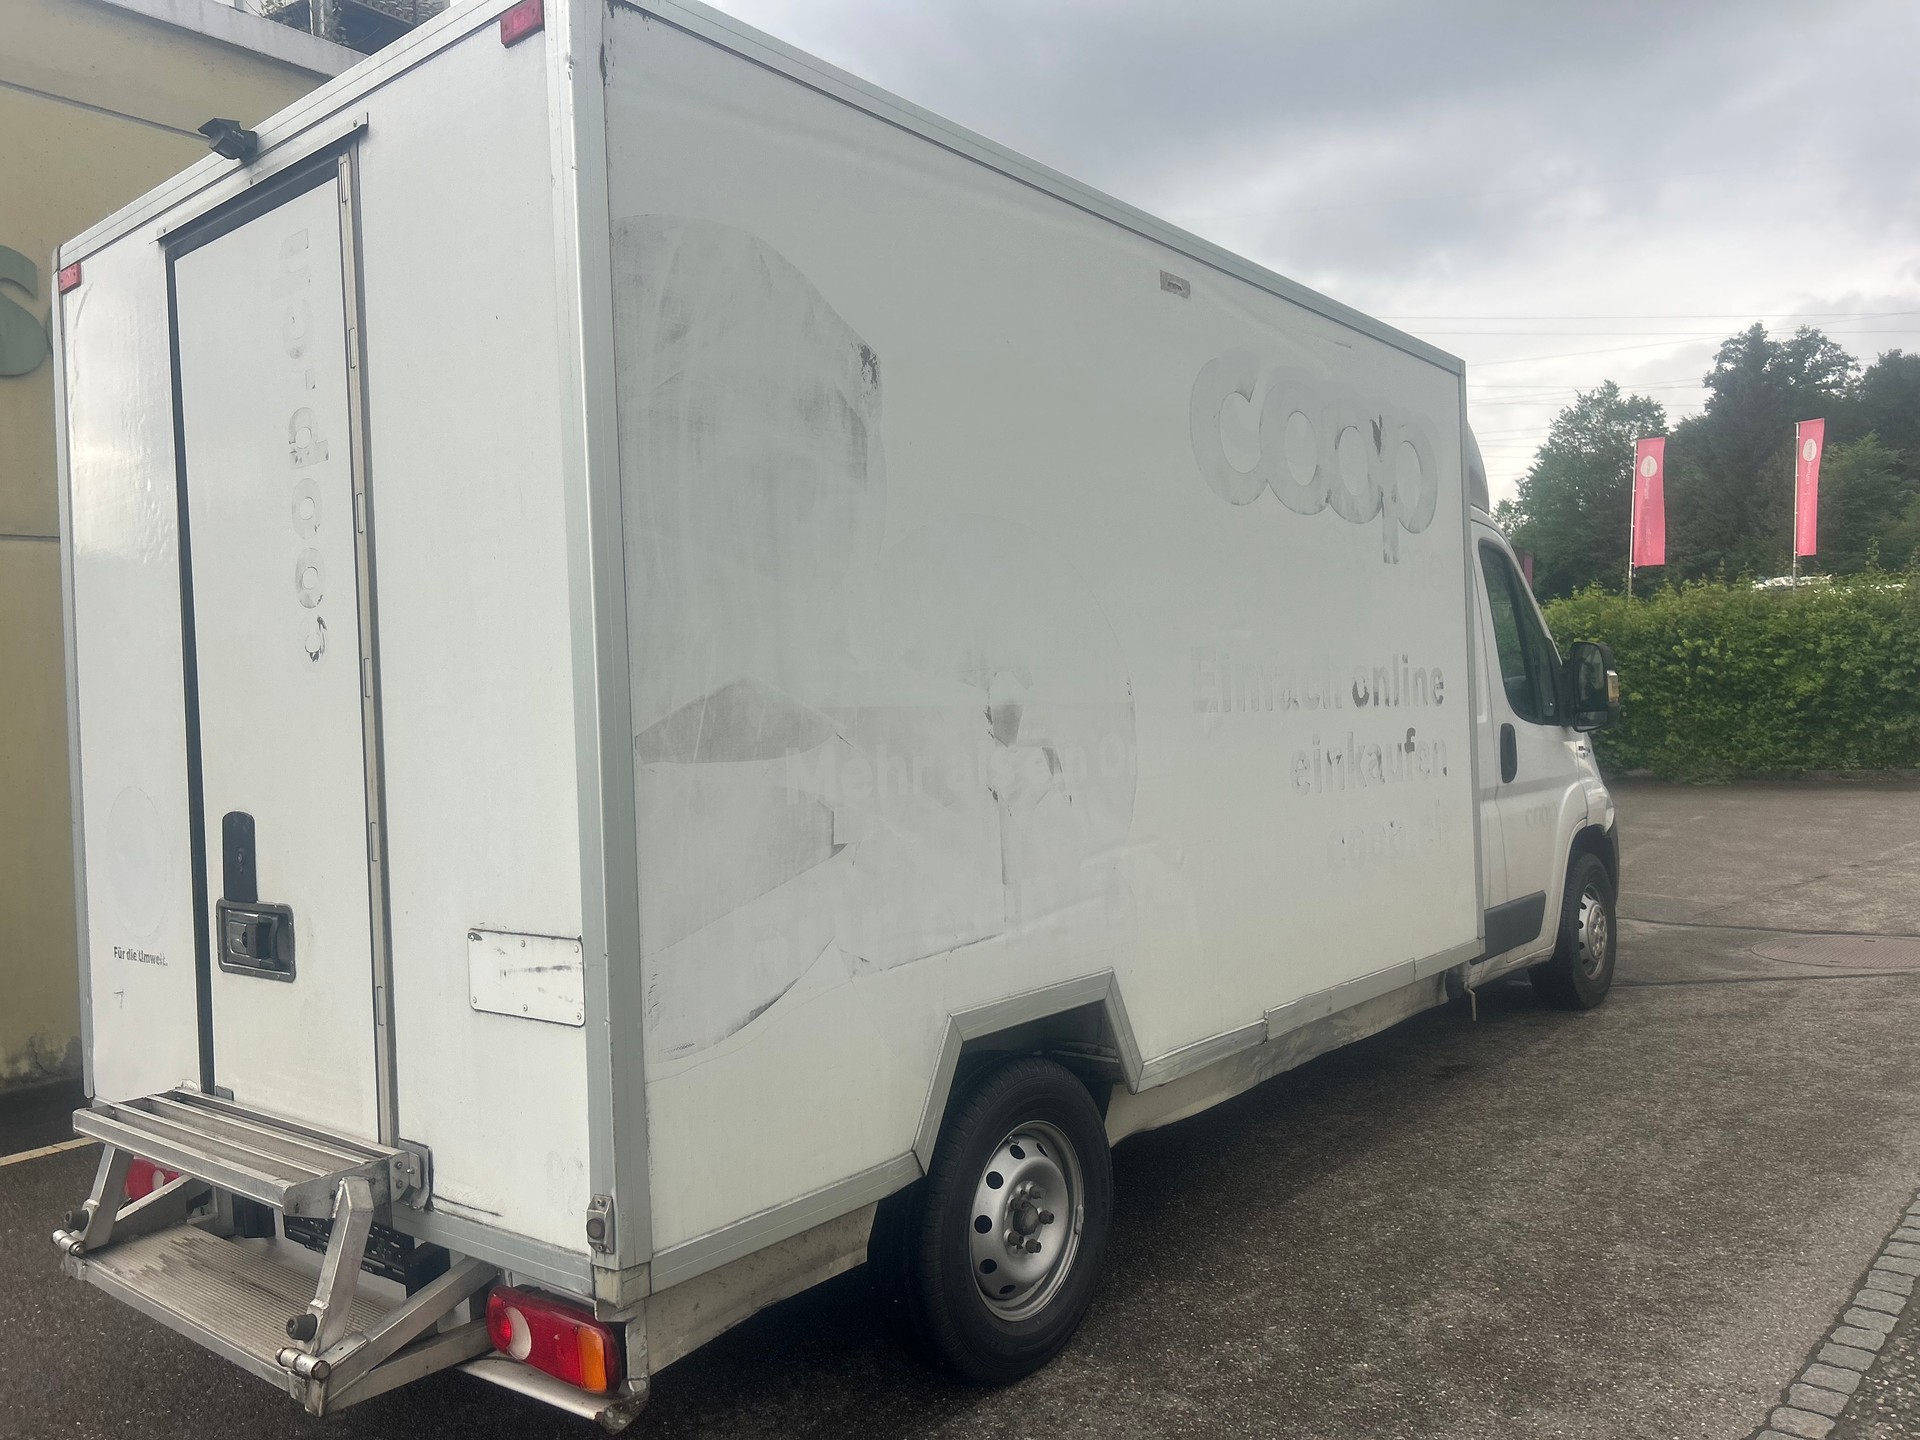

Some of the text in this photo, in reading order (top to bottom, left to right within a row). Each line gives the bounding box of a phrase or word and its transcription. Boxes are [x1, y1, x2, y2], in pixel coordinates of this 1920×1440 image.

[1190, 350, 1438, 565] coop
[1191, 647, 1444, 712] Einfach online
[1290, 727, 1448, 797] einkaufen
[113, 946, 126, 960] Für
[126, 948, 137, 961] die
